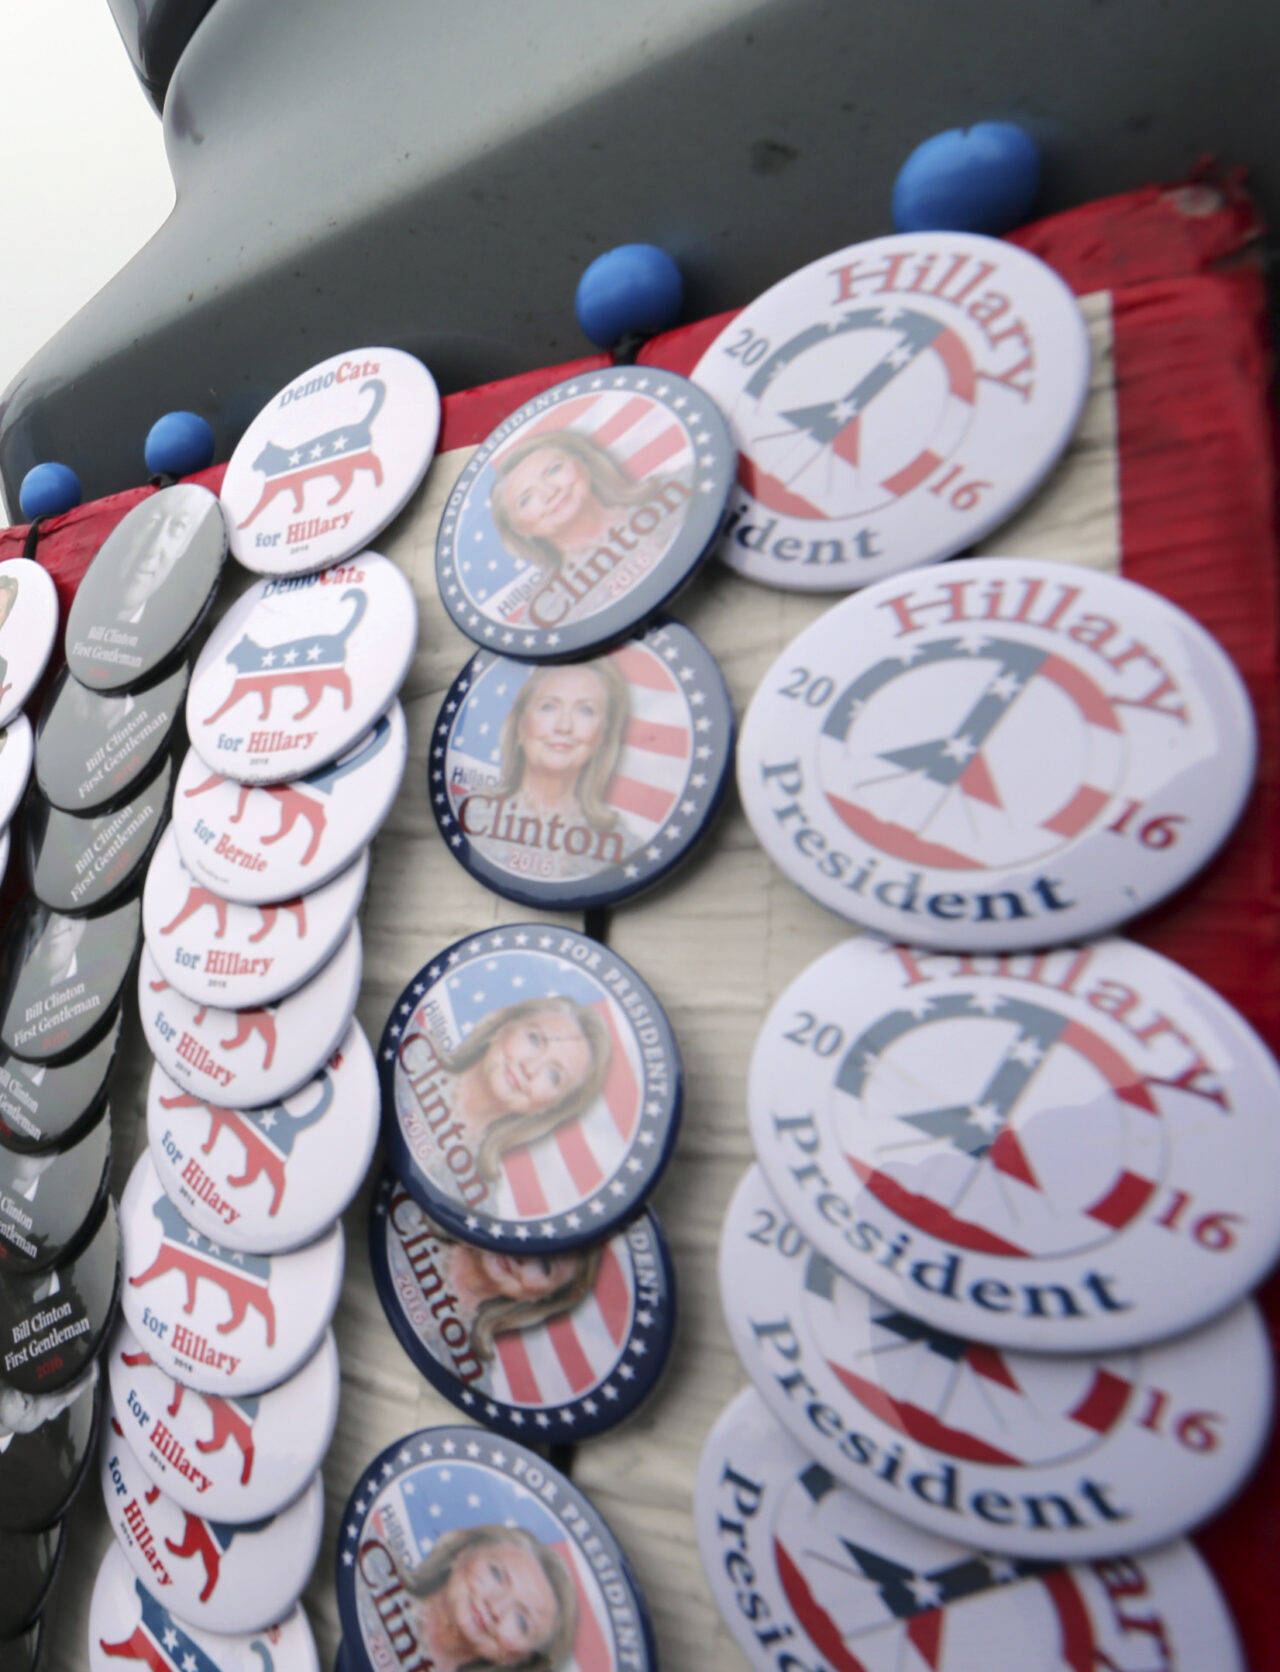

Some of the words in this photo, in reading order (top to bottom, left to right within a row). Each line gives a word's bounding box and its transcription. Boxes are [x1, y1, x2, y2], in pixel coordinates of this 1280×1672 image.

[724, 328, 768, 366] 20
[828, 252, 1034, 400] Hillary
[278, 360, 381, 408] DemoCats
[469, 386, 564, 473] PRESIDENT
[926, 463, 993, 510] 16
[255, 531, 281, 548] for
[285, 510, 354, 546] Hillary
[528, 477, 695, 629] Clinton
[723, 505, 883, 564] ident
[876, 578, 1188, 725] Hillary
[778, 667, 834, 708] 20
[77, 769, 104, 799] First
[103, 711, 169, 772] Gentleman
[85, 747, 106, 773] Bill
[105, 709, 149, 752] Clinton
[217, 731, 245, 753] for
[246, 729, 318, 754] Hillary
[70, 870, 97, 902] First
[94, 804, 155, 873] Gentleman
[74, 847, 95, 876] Bill
[93, 805, 134, 852] Clinton
[193, 818, 217, 846] for
[213, 832, 269, 873] Bernie
[458, 793, 625, 864] Clinton
[760, 757, 1076, 922] President
[1108, 798, 1186, 850] 16
[508, 849, 555, 876] 2016
[174, 946, 201, 970] for
[203, 948, 274, 977] Hillary
[13, 1025, 36, 1047] First
[37, 994, 101, 1033] Gentleman
[24, 1000, 44, 1022] Bill
[43, 982, 86, 1012] Clinton
[559, 936, 602, 970] FOR
[603, 967, 668, 1098] PRESIDENT
[783, 1011, 844, 1057] 20
[153, 1010, 177, 1043] for
[175, 1030, 238, 1088] Hillary
[398, 1032, 490, 1209] Clinton
[161, 1129, 183, 1165] for
[180, 1157, 242, 1225] Hillary
[0, 1195, 34, 1231] Clinton
[746, 1210, 808, 1258] 20
[770, 1109, 1132, 1317] President
[1154, 1191, 1242, 1252] 16
[388, 1190, 484, 1384] Clinton
[4, 1350, 29, 1372] First
[28, 1317, 92, 1358] Gentleman
[11, 1319, 31, 1345] Bill
[30, 1302, 73, 1334] Clinton
[142, 1306, 168, 1340] for
[170, 1323, 242, 1376] Hillary
[126, 1389, 151, 1427] for
[149, 1419, 214, 1494] Hillary
[748, 1314, 1132, 1530] President
[1136, 1387, 1226, 1454] 16
[108, 1455, 128, 1497] for
[122, 1497, 175, 1587] Hillary
[511, 1457, 558, 1502] FOR
[561, 1502, 641, 1670] PRESIDENT
